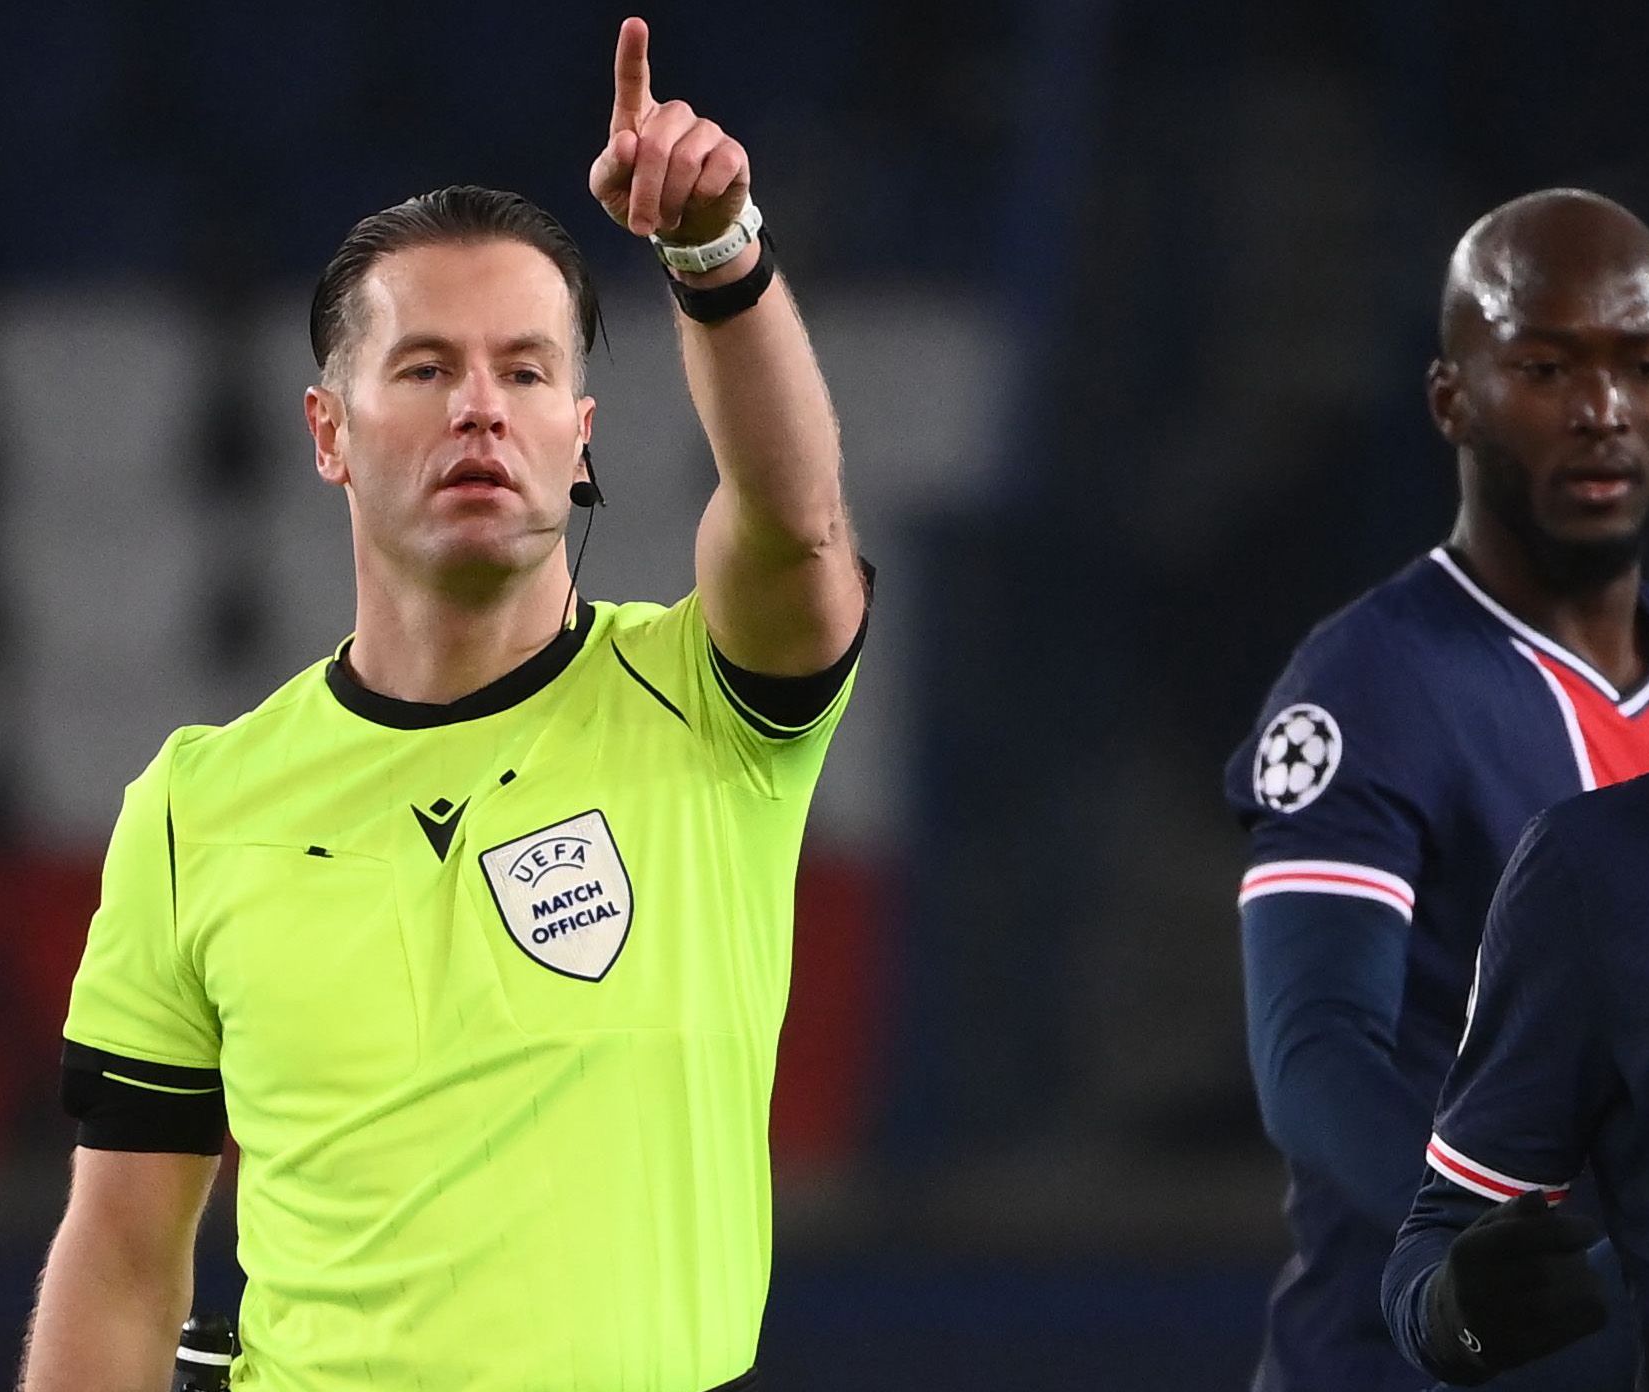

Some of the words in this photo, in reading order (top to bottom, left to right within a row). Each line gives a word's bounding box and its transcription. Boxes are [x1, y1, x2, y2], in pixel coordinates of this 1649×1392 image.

[515, 843, 586, 882] UEFA
[532, 880, 604, 919] MATCH
[531, 901, 621, 944] OFFICIAL
